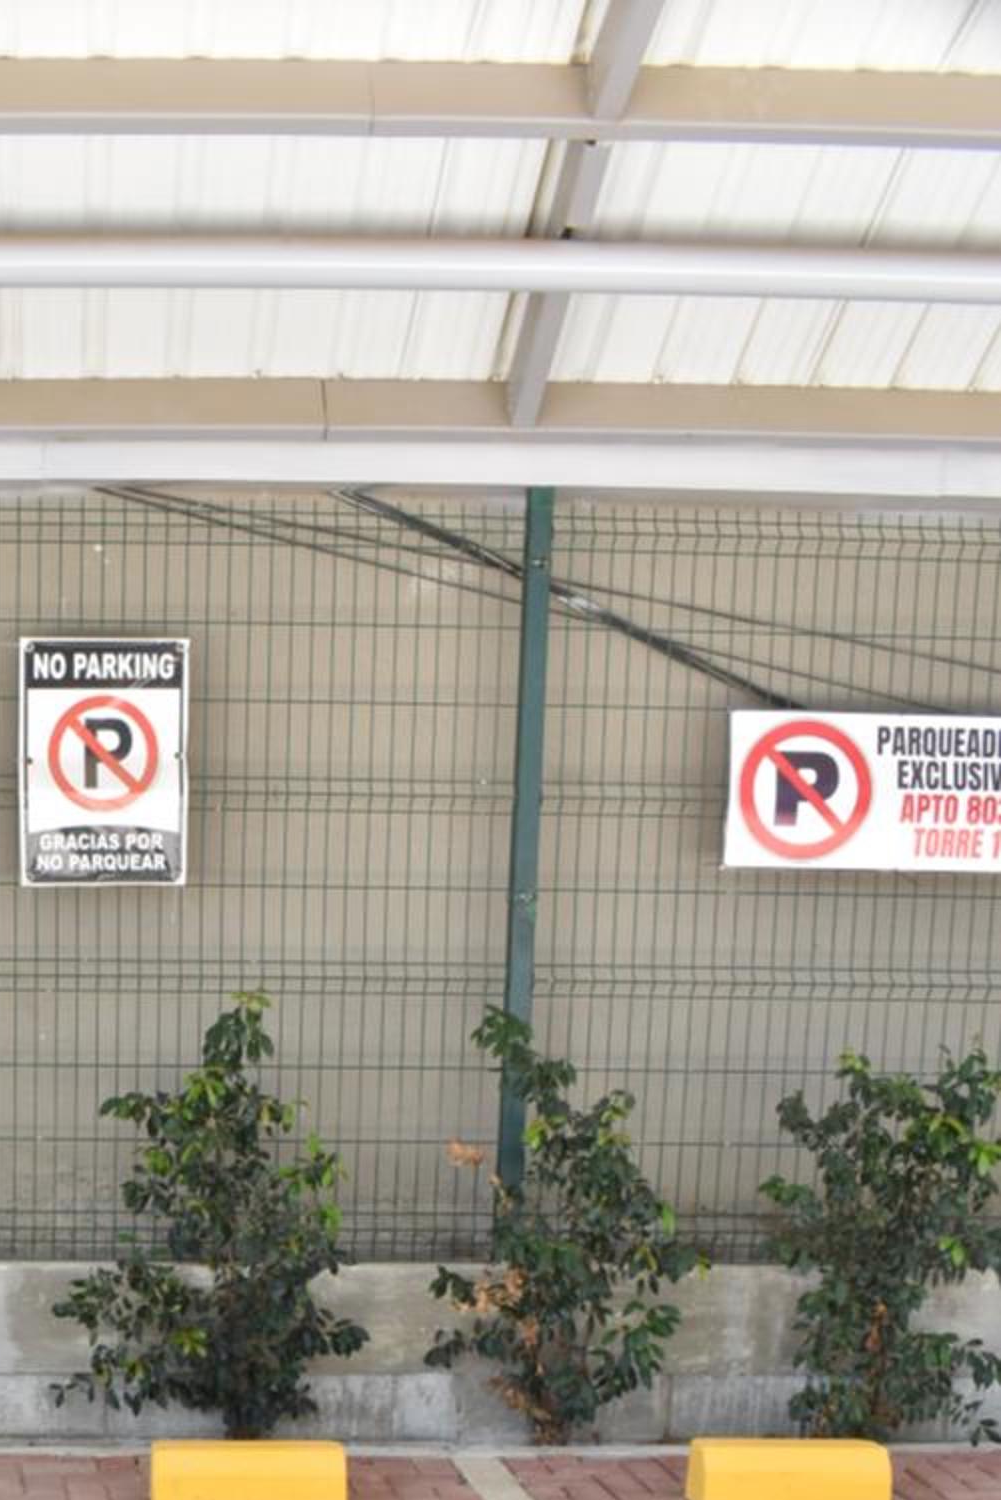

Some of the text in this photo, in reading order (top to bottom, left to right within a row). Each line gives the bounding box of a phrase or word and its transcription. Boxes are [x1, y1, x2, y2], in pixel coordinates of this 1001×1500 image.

[33, 653, 175, 680] NO PARKING
[877, 726, 1001, 758] PARQUEAD
[900, 794, 1001, 825] APTO 80
[40, 833, 164, 851] GRACIAS POR
[914, 828, 984, 858] TORRE
[36, 854, 167, 871] NO PARQUEAR
